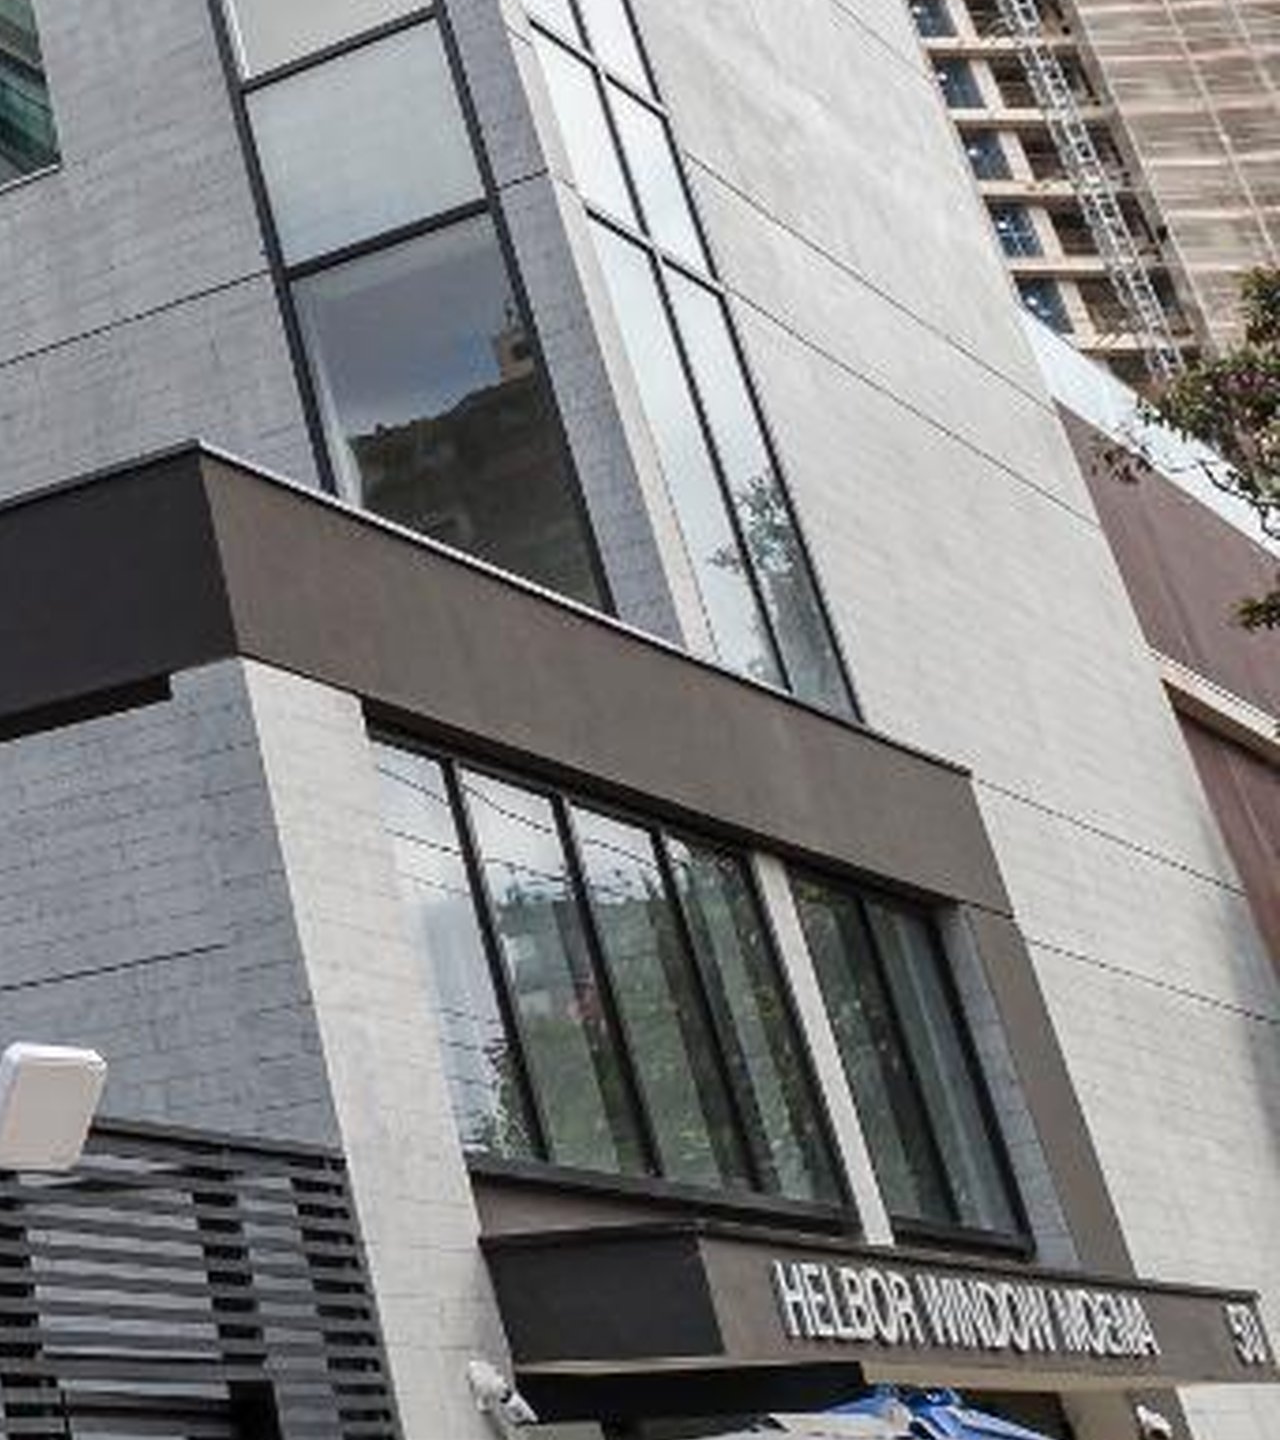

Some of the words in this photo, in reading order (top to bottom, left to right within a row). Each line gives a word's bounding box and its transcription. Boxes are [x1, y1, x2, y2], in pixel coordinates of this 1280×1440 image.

[774, 1259, 925, 1343] HELBOR
[915, 1274, 1056, 1351] WINDOW
[1049, 1289, 1161, 1356] MOEMA
